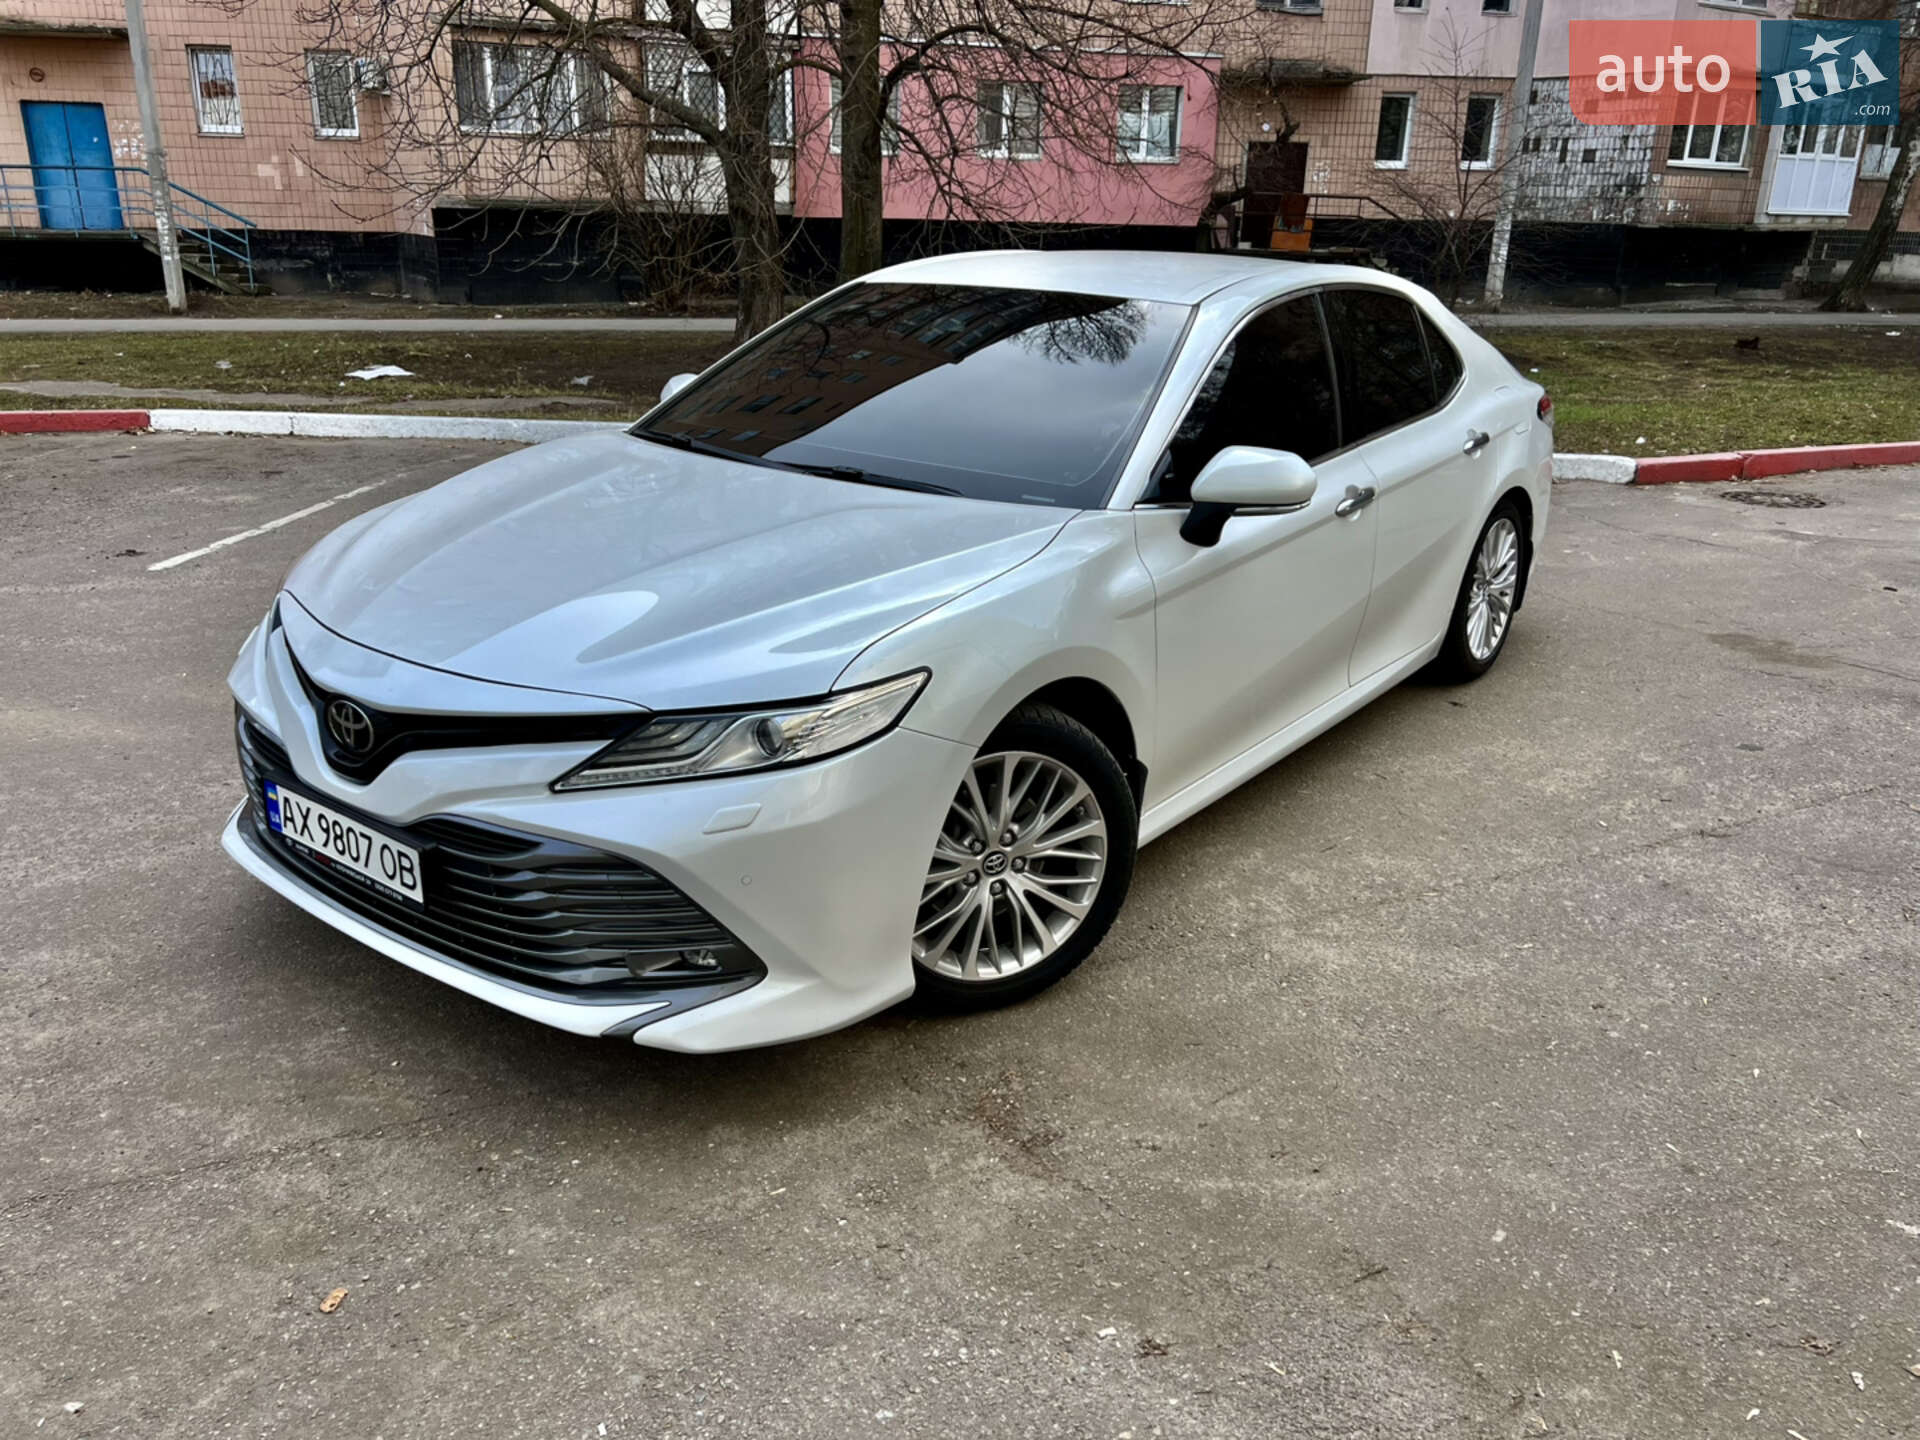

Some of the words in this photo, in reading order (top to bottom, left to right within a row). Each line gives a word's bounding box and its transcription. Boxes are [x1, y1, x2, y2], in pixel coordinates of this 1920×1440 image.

[283, 796, 315, 842] AX
[318, 812, 372, 868] 9807
[380, 843, 417, 891] OB
